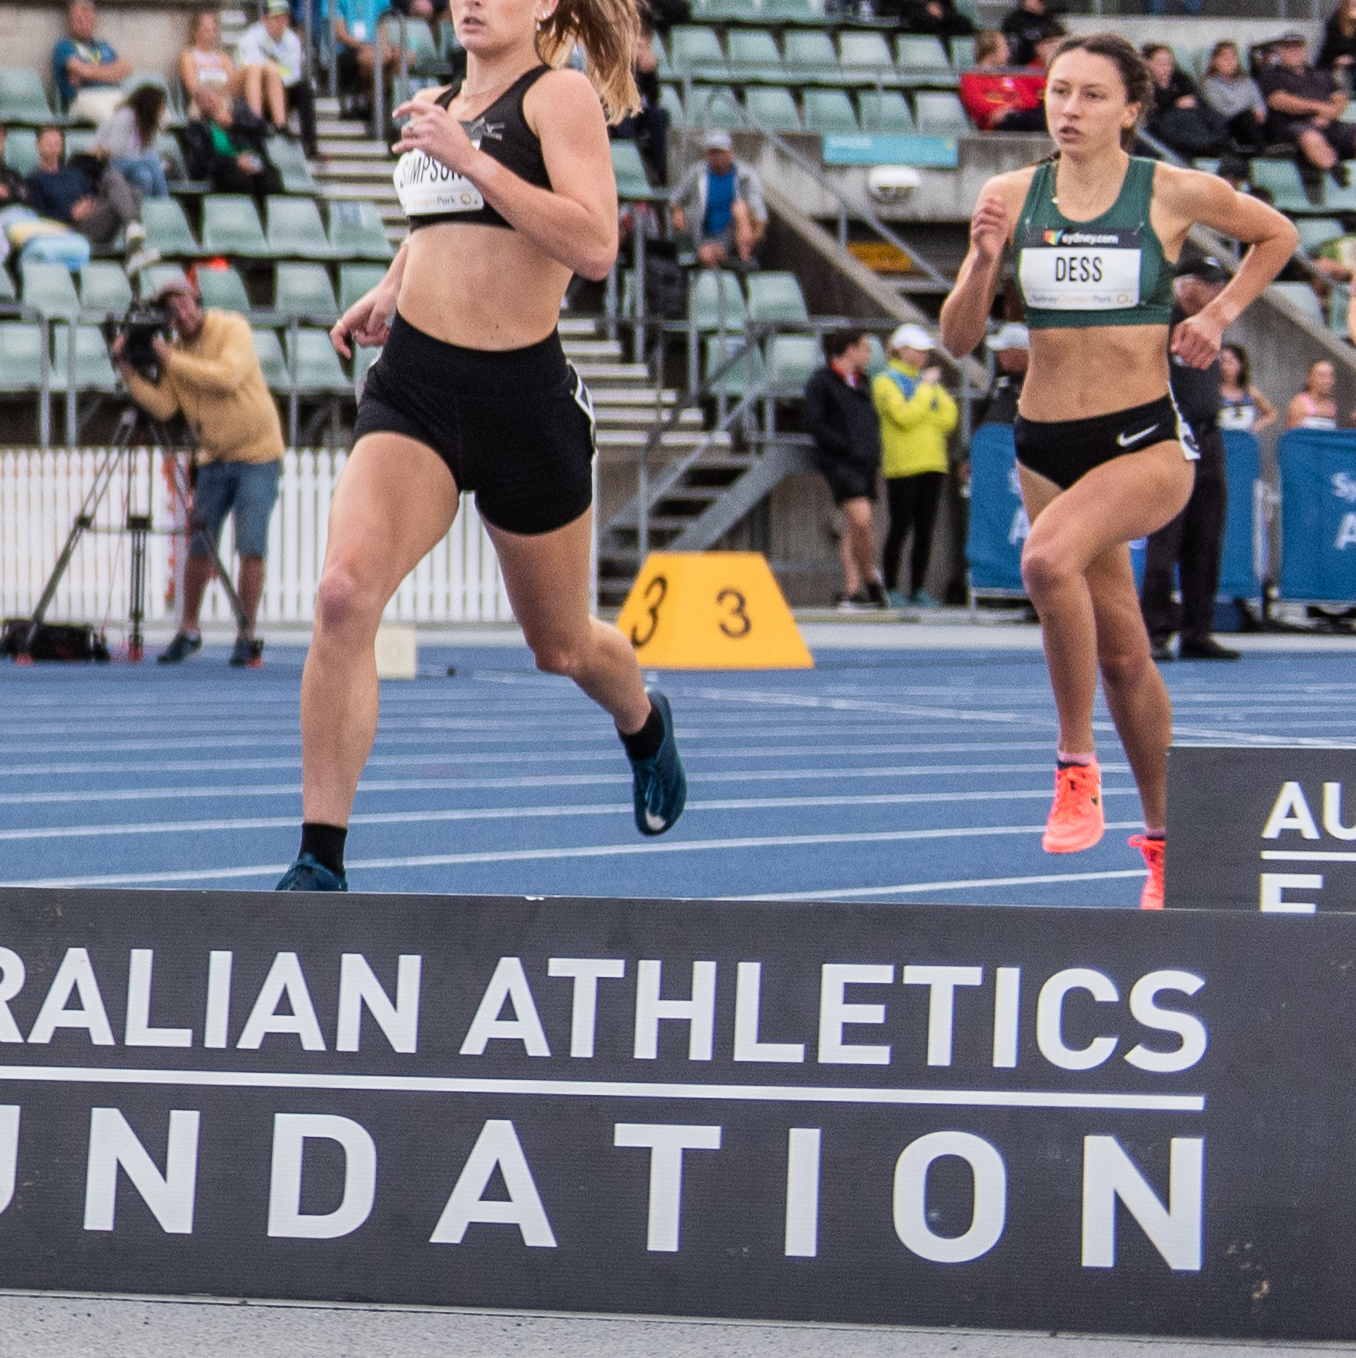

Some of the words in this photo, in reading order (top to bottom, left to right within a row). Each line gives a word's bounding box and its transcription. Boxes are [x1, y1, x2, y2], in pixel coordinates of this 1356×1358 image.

[1061, 233, 1119, 245] sydney.com
[1055, 256, 1103, 282] DESS
[630, 575, 668, 649] 3
[716, 586, 752, 640] 3
[459, 956, 1207, 1073] ATHLETICS
